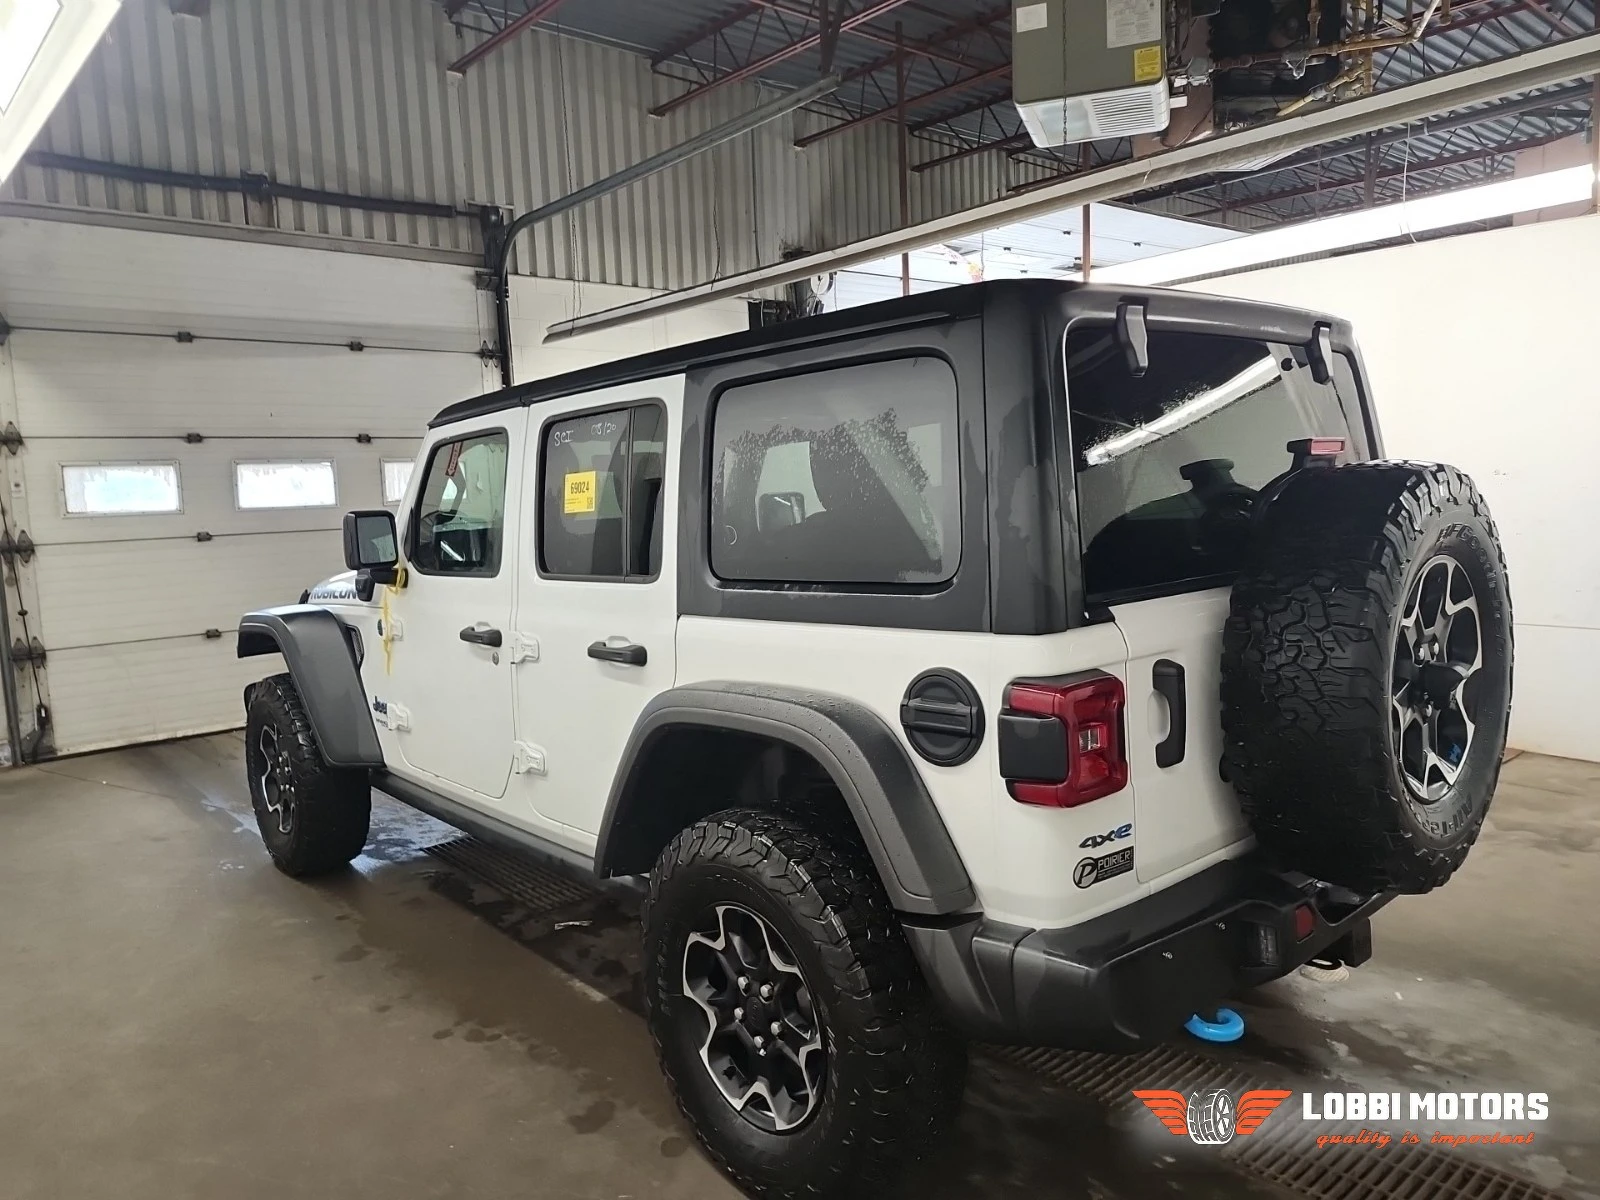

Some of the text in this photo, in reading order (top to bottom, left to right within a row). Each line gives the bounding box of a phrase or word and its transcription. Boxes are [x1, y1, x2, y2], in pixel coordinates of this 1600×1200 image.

[570, 481, 590, 495] 69024
[310, 588, 357, 600] RUBICON
[1078, 823, 1133, 849] 4xe
[1097, 849, 1132, 871] POIRIER
